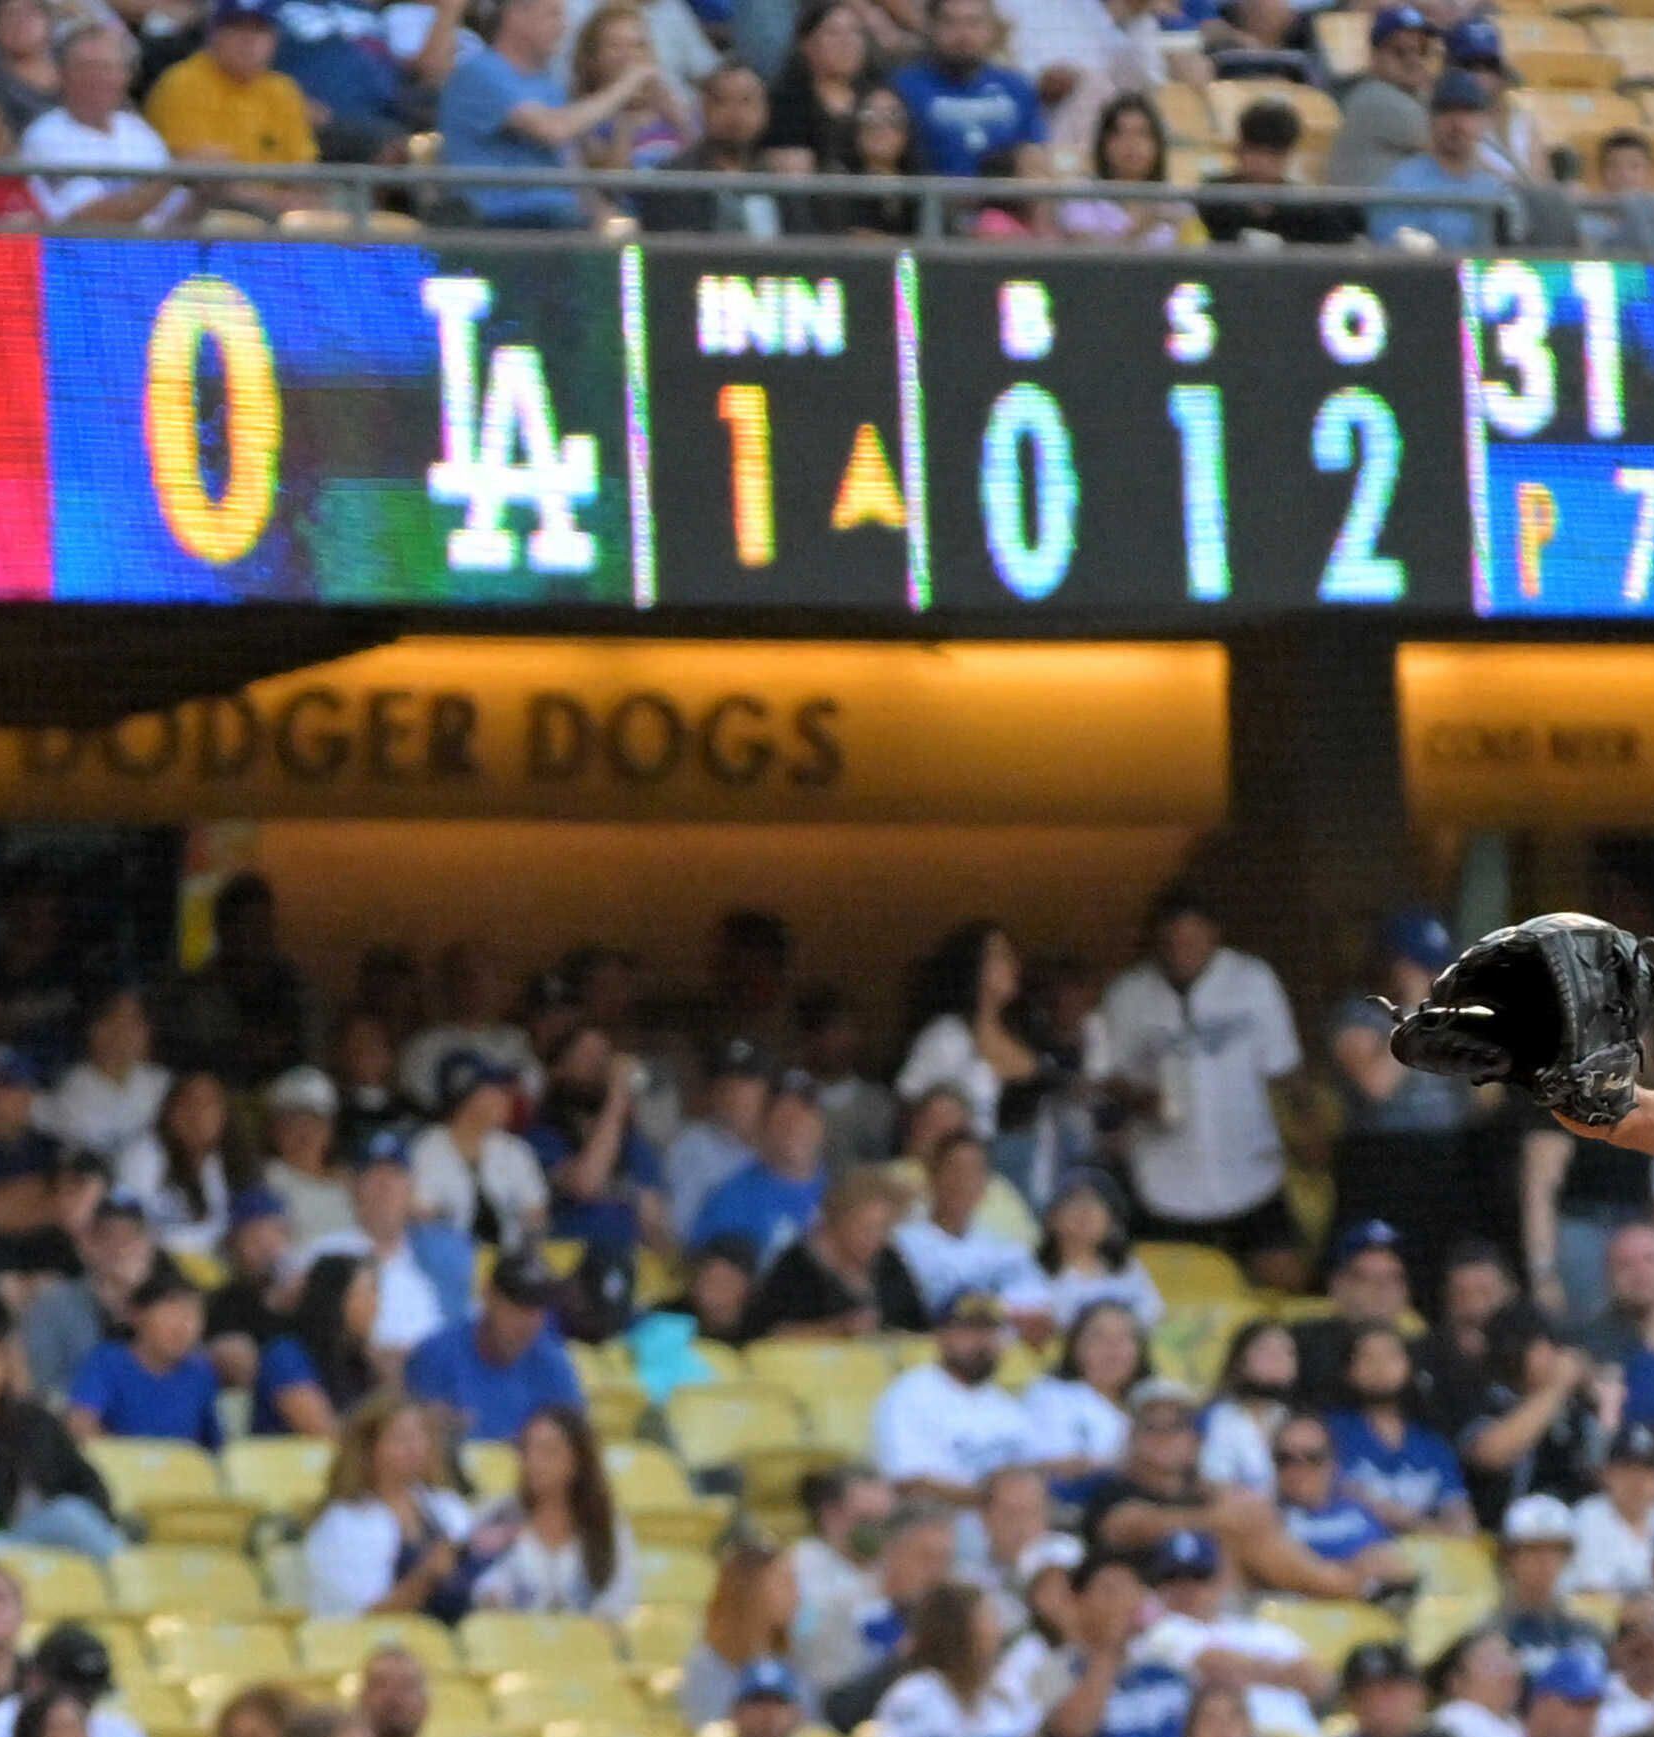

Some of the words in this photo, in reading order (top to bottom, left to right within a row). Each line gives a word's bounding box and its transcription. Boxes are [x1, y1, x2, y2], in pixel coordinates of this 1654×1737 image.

[697, 275, 845, 356] INN
[999, 281, 1055, 361] B
[1167, 282, 1218, 363] S
[1319, 284, 1387, 367] O
[1479, 261, 1624, 440] 31
[146, 275, 281, 563] 0
[422, 277, 598, 573] LA
[718, 384, 776, 567] 1
[980, 382, 1079, 601] 0
[1168, 384, 1230, 601] 1
[1311, 387, 1406, 603] 2
[1515, 481, 1559, 599] P
[527, 690, 845, 788] DOGS
